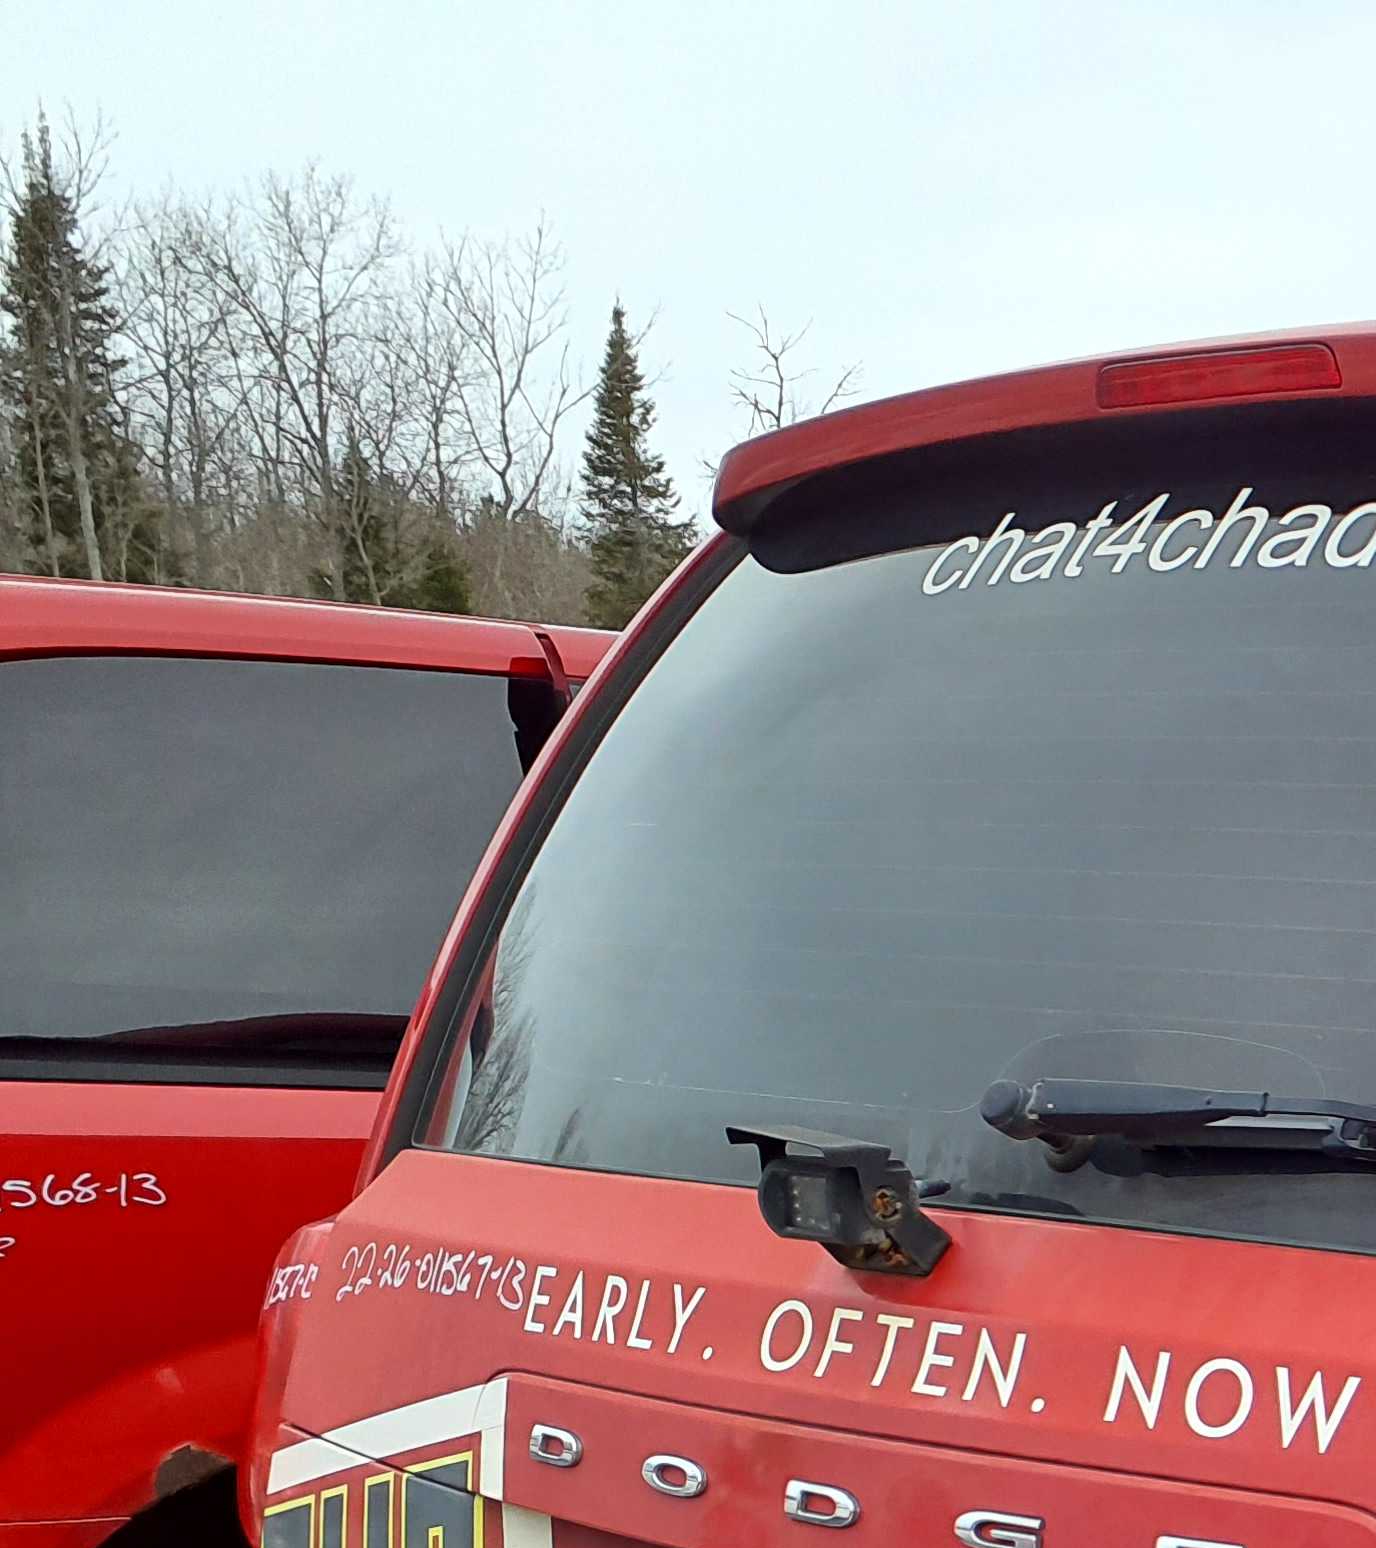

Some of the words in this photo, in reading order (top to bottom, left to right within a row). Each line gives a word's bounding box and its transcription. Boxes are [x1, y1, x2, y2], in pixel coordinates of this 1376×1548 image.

[522, 1266, 714, 1361] EARLY.
[759, 1298, 1047, 1414] OFTEN.
[1103, 1345, 1361, 1454] NOW
